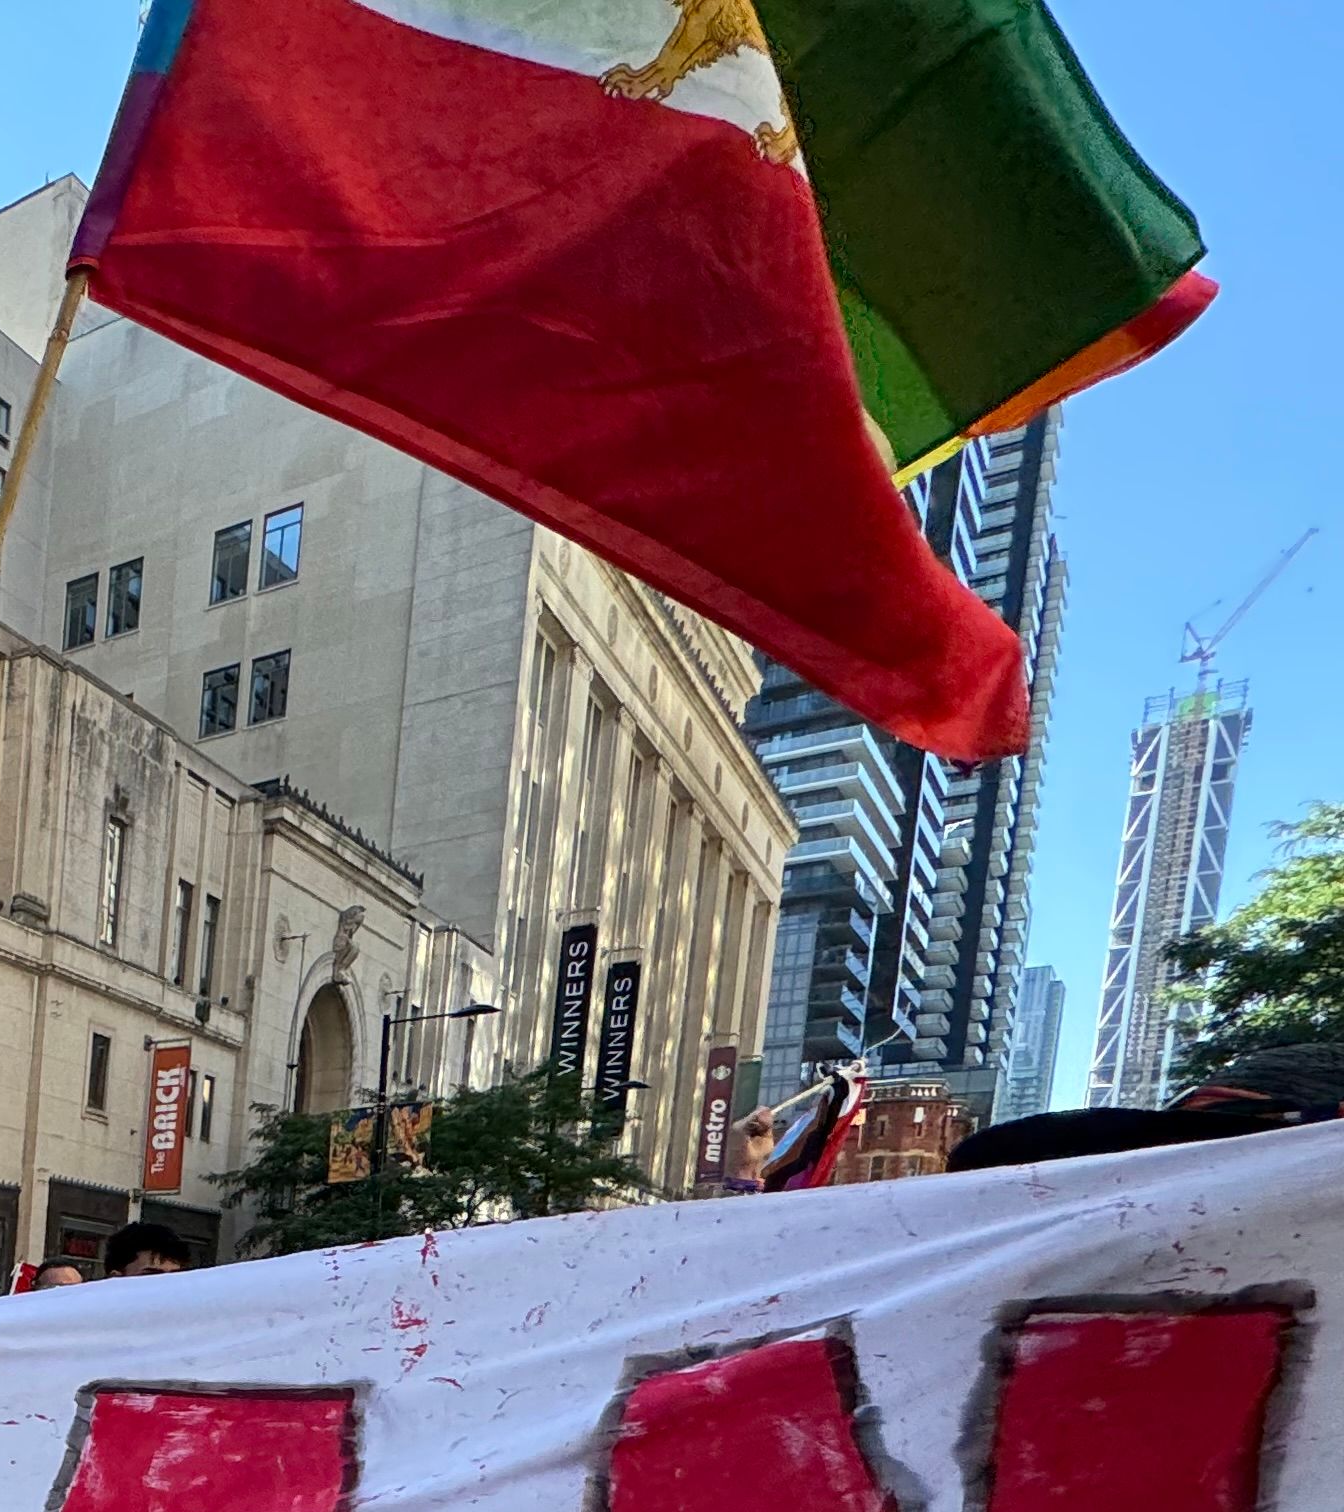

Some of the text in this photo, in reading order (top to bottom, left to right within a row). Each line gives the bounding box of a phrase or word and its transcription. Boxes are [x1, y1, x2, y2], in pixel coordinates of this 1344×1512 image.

[558, 941, 589, 1076] WINNERS
[603, 976, 632, 1101] WINNERS
[151, 1067, 181, 1175] The BRICK
[705, 1099, 727, 1163] metro
